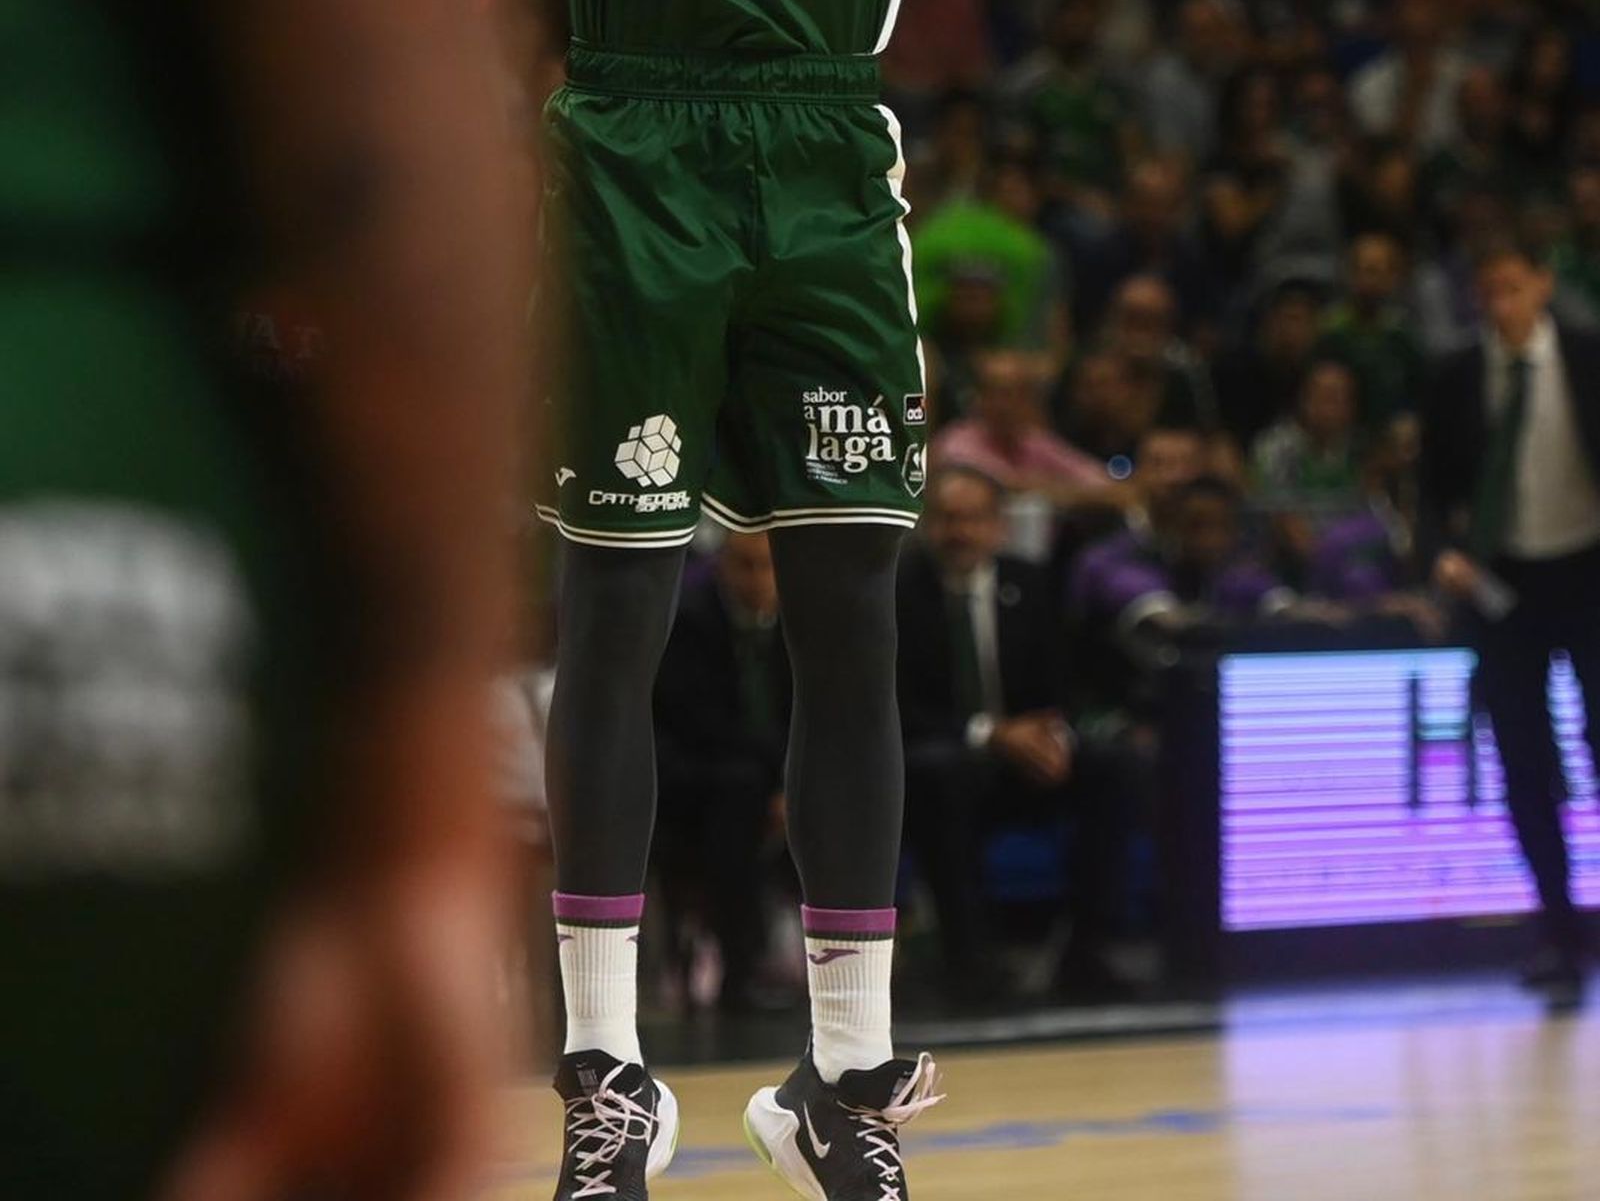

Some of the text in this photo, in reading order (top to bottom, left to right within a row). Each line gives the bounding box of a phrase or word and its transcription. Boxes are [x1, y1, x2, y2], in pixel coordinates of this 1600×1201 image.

[802, 387, 847, 403] sabor
[804, 406, 816, 420] a
[805, 423, 896, 474] laga
